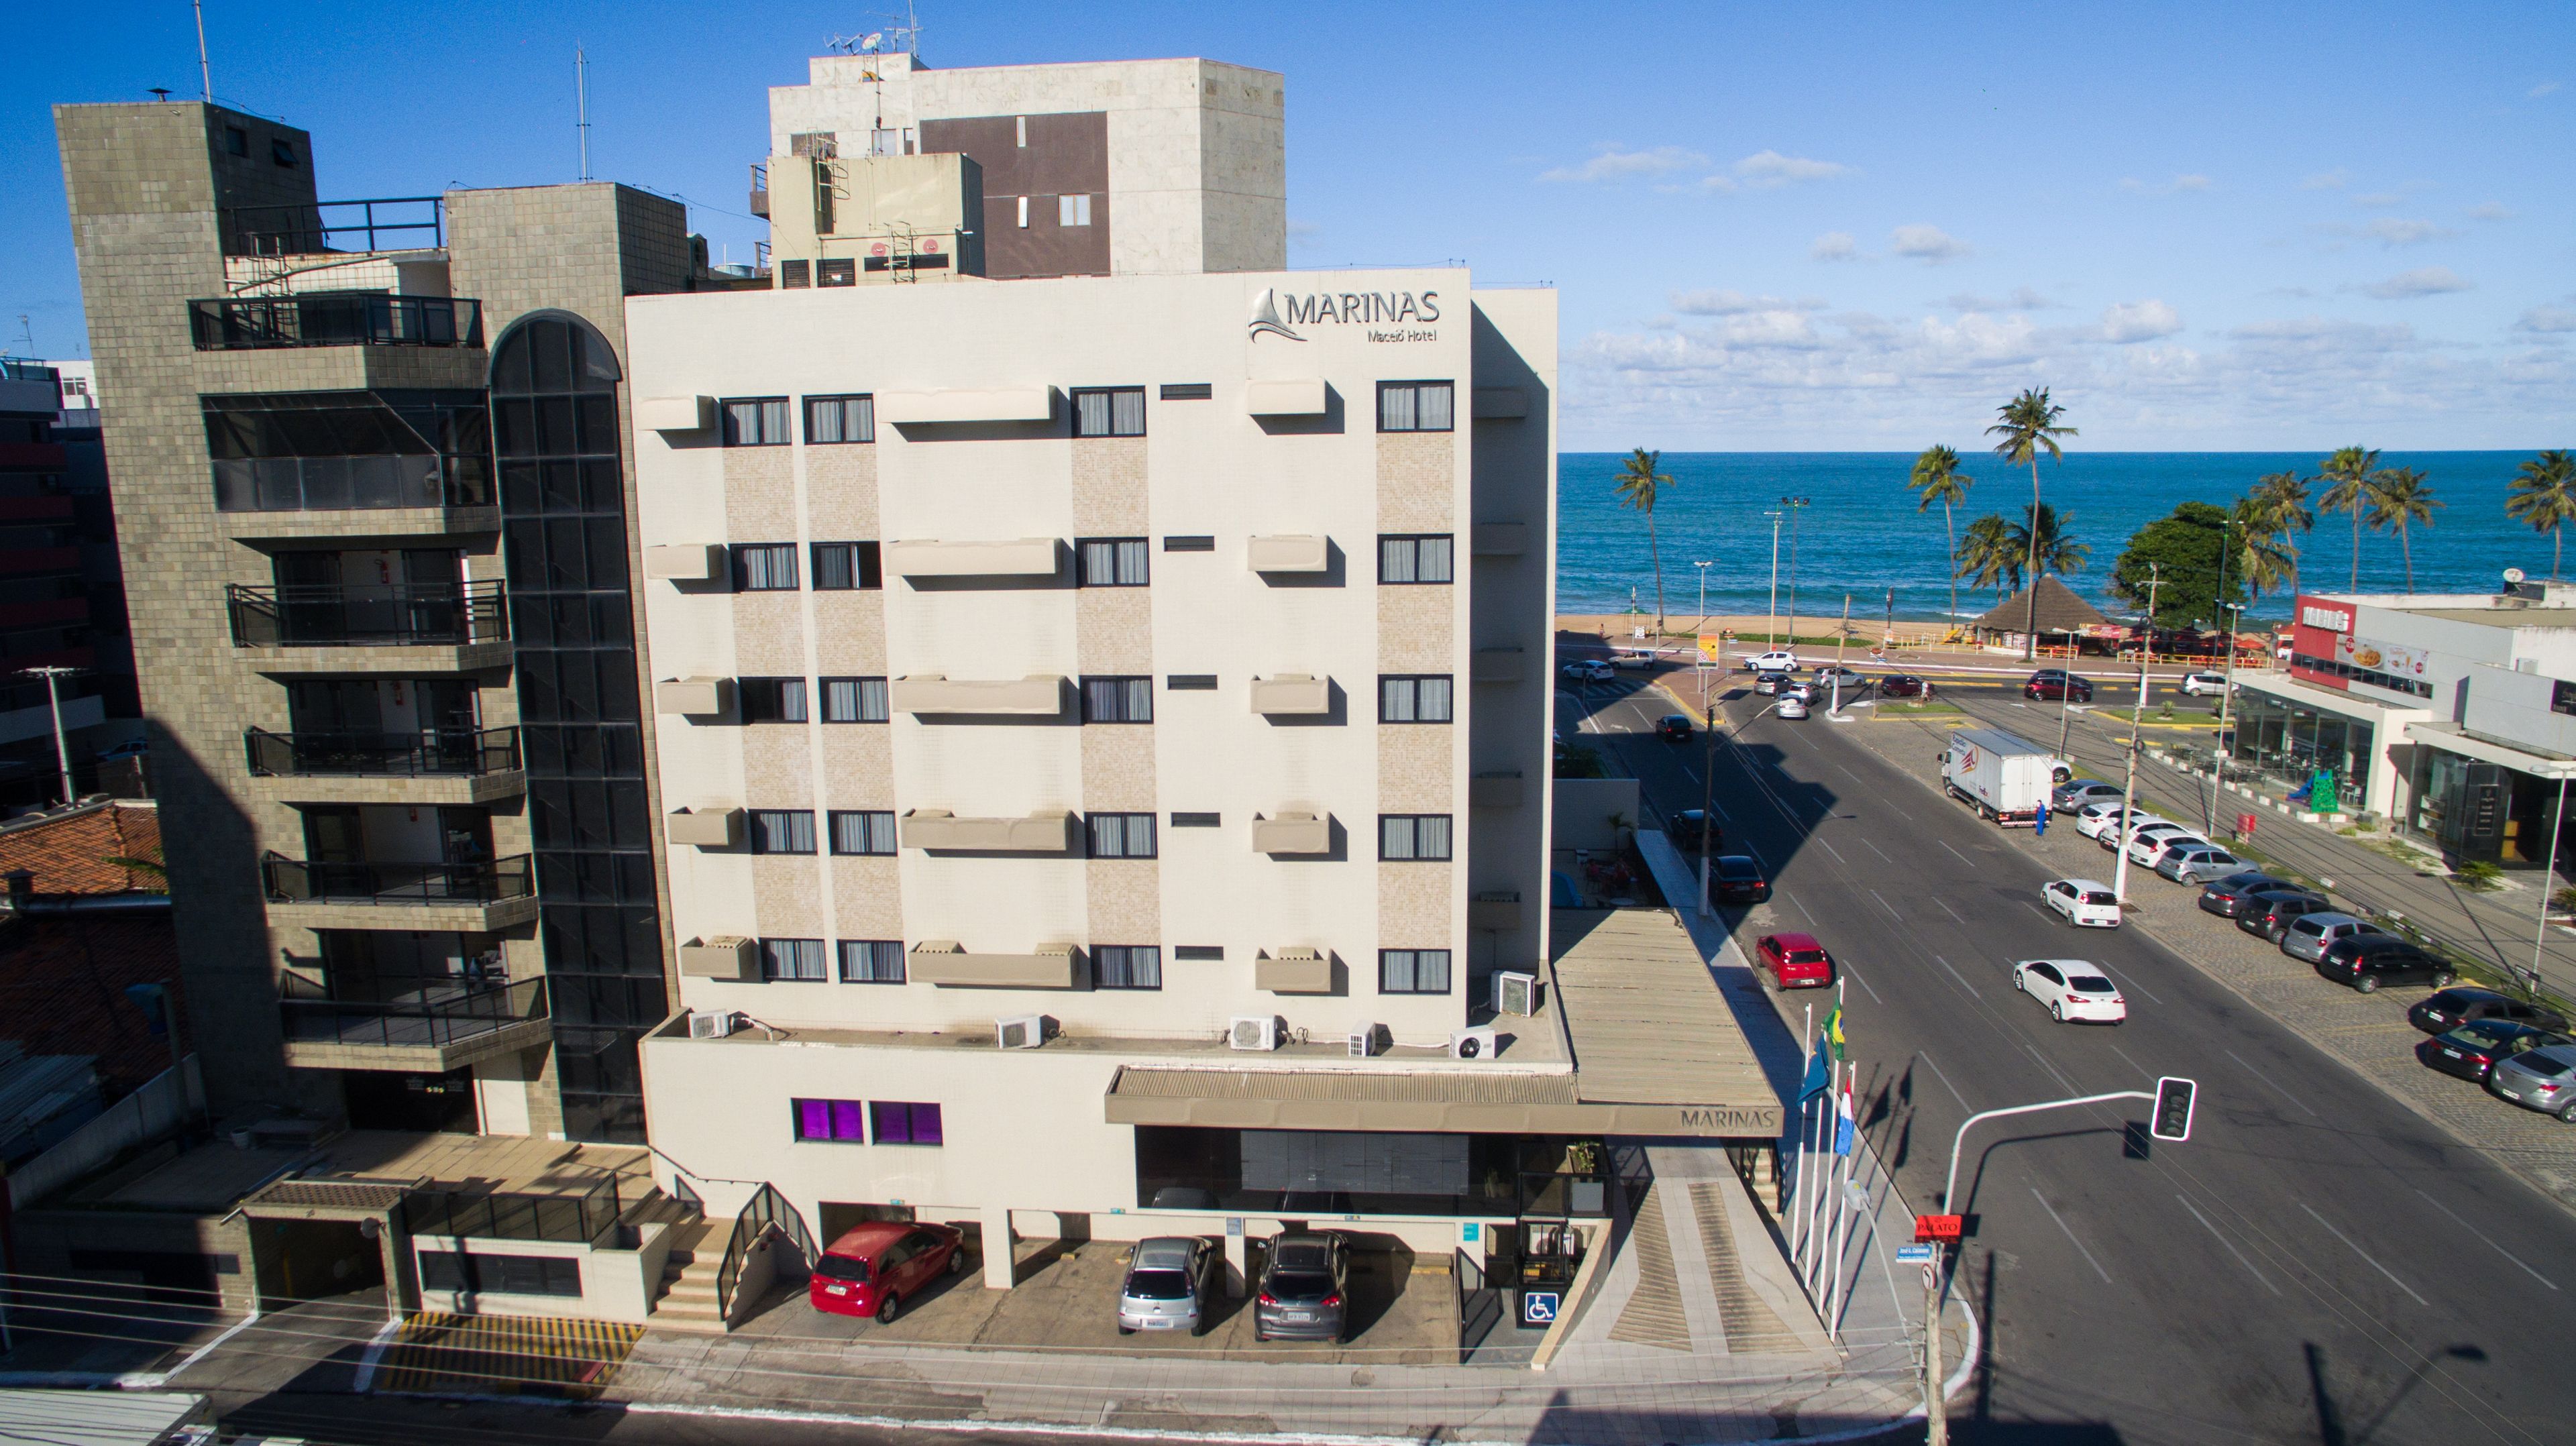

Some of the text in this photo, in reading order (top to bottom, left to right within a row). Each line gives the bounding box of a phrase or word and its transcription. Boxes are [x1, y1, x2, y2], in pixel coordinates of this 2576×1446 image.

[1283, 291, 1440, 324] MARINAS
[1368, 329, 1437, 342] Maceió Hotel
[1680, 1110, 1774, 1127] MARINAS
[1918, 1223, 1957, 1232] PALATO
